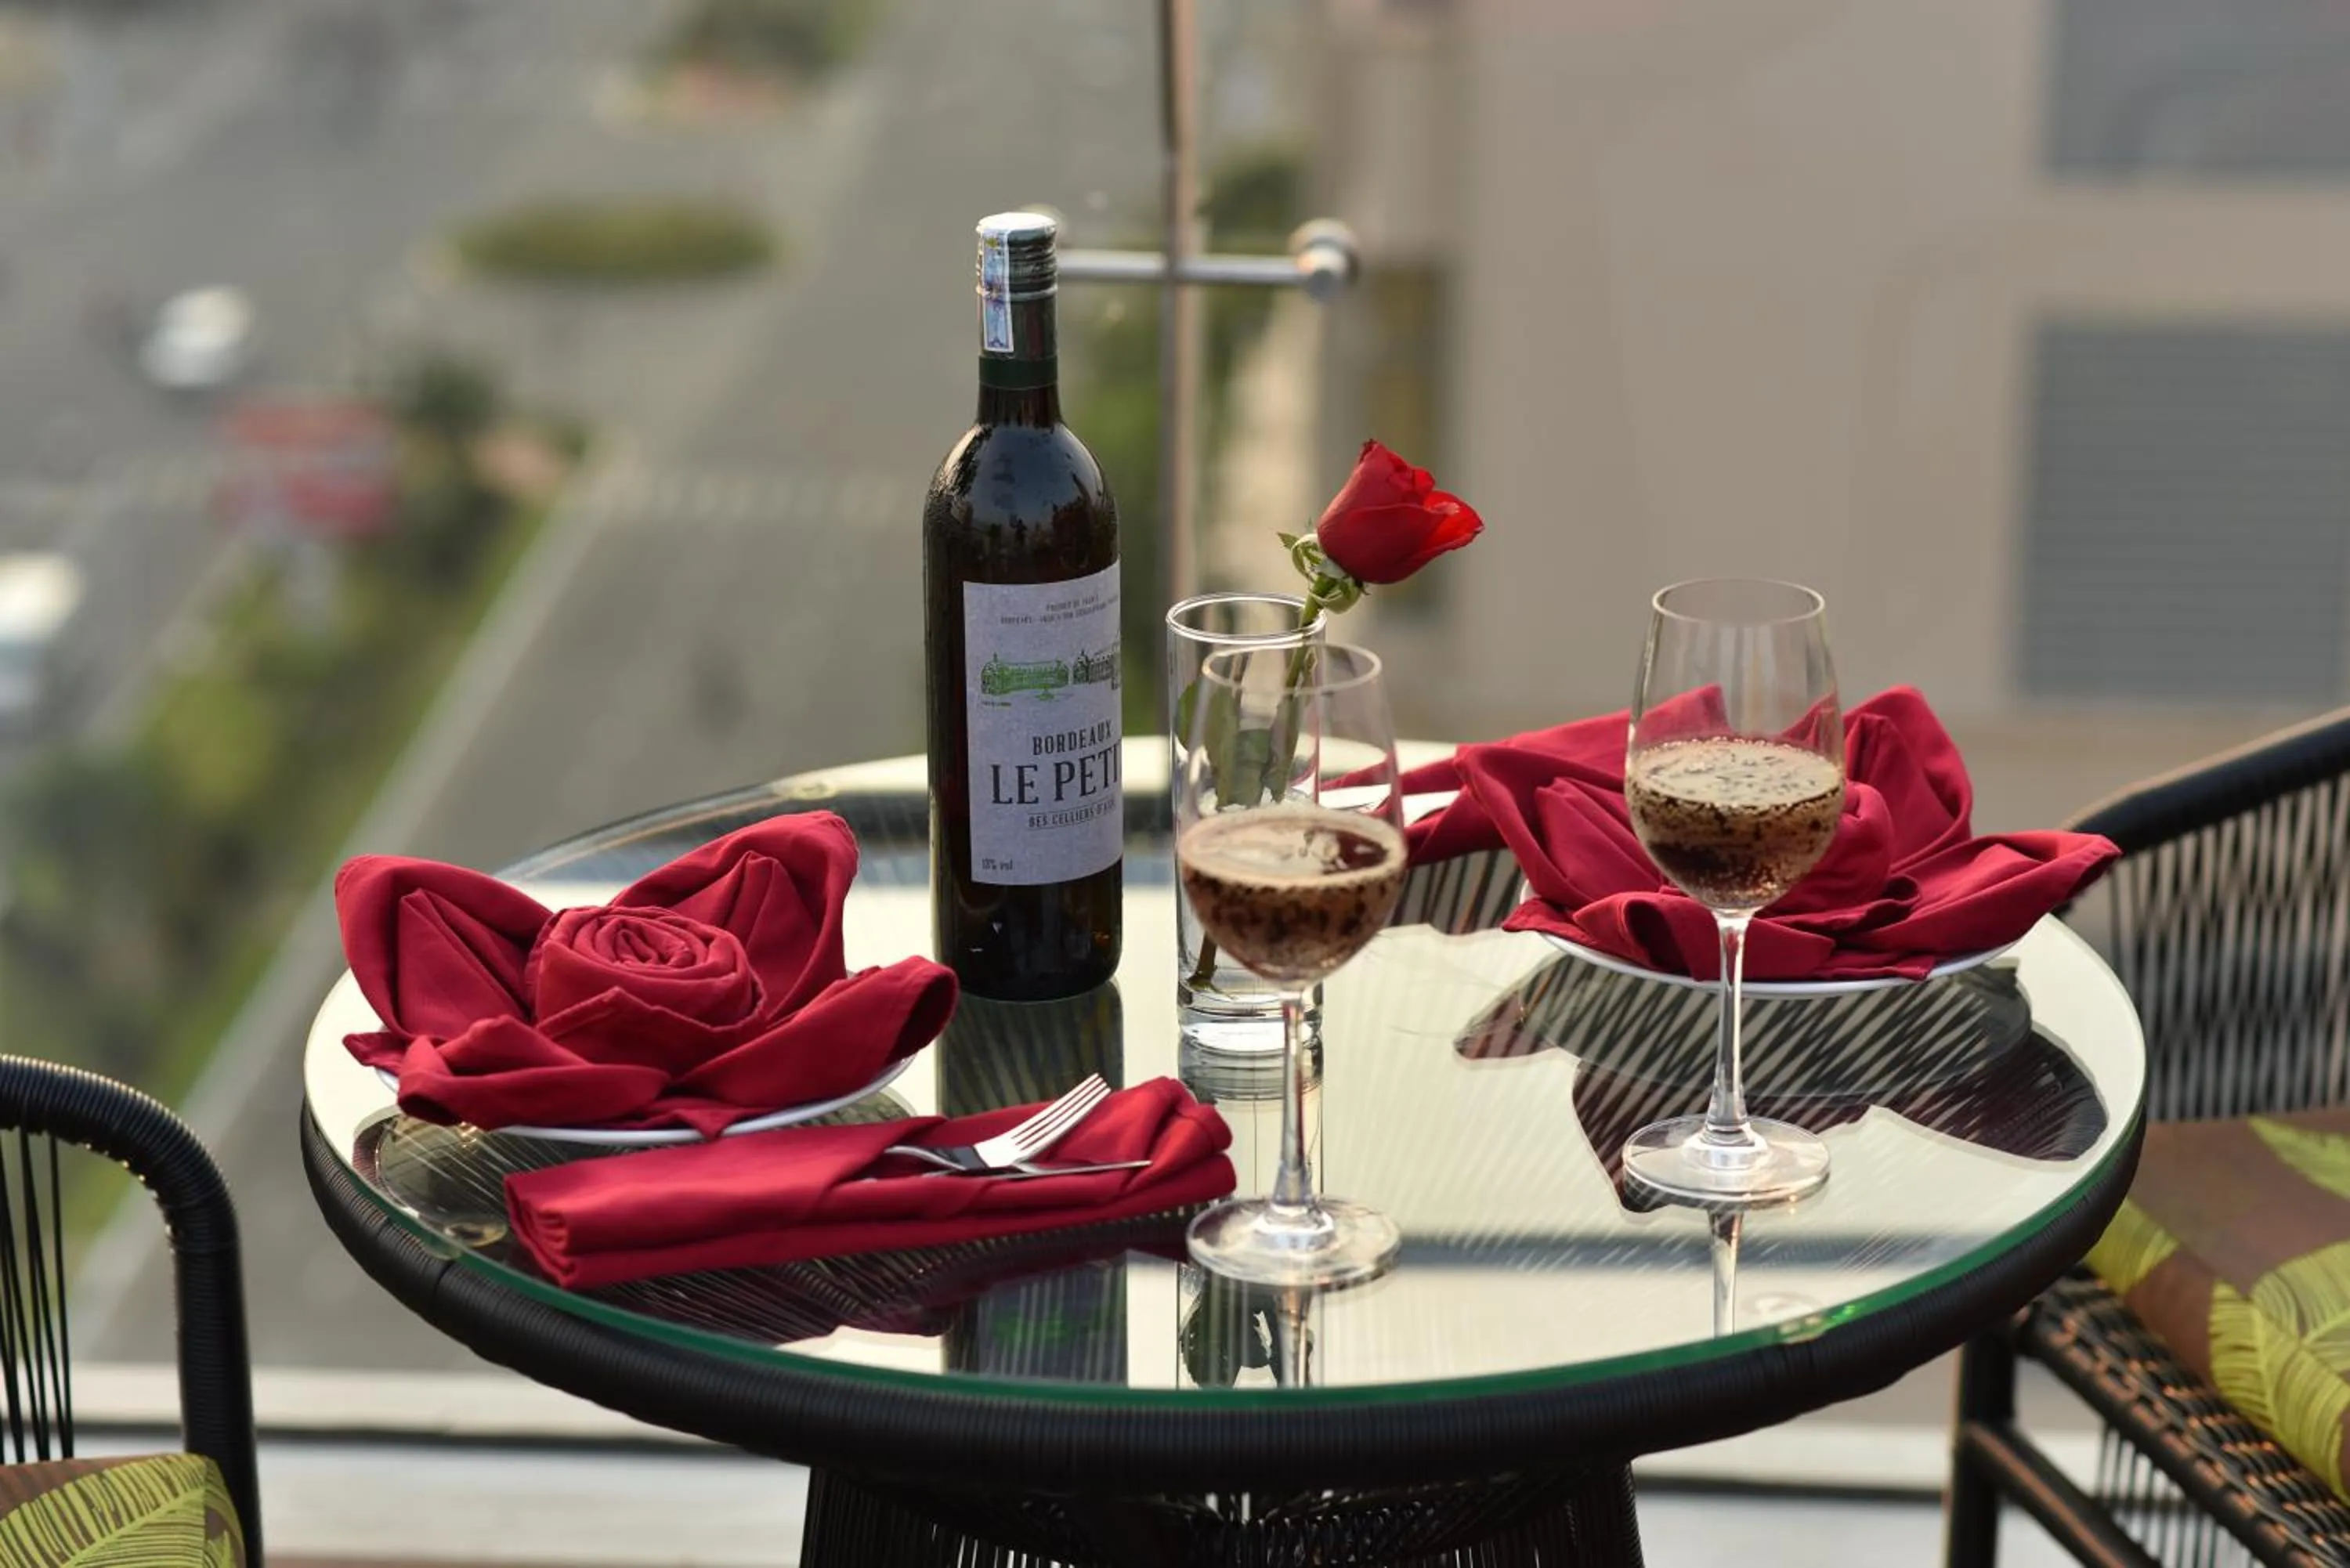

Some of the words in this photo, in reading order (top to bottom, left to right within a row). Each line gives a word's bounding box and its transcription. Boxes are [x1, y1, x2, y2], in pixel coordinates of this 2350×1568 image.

[1032, 719, 1112, 755] BORDEAUX
[990, 764, 1039, 804] LE
[1054, 739, 1121, 801] PETI
